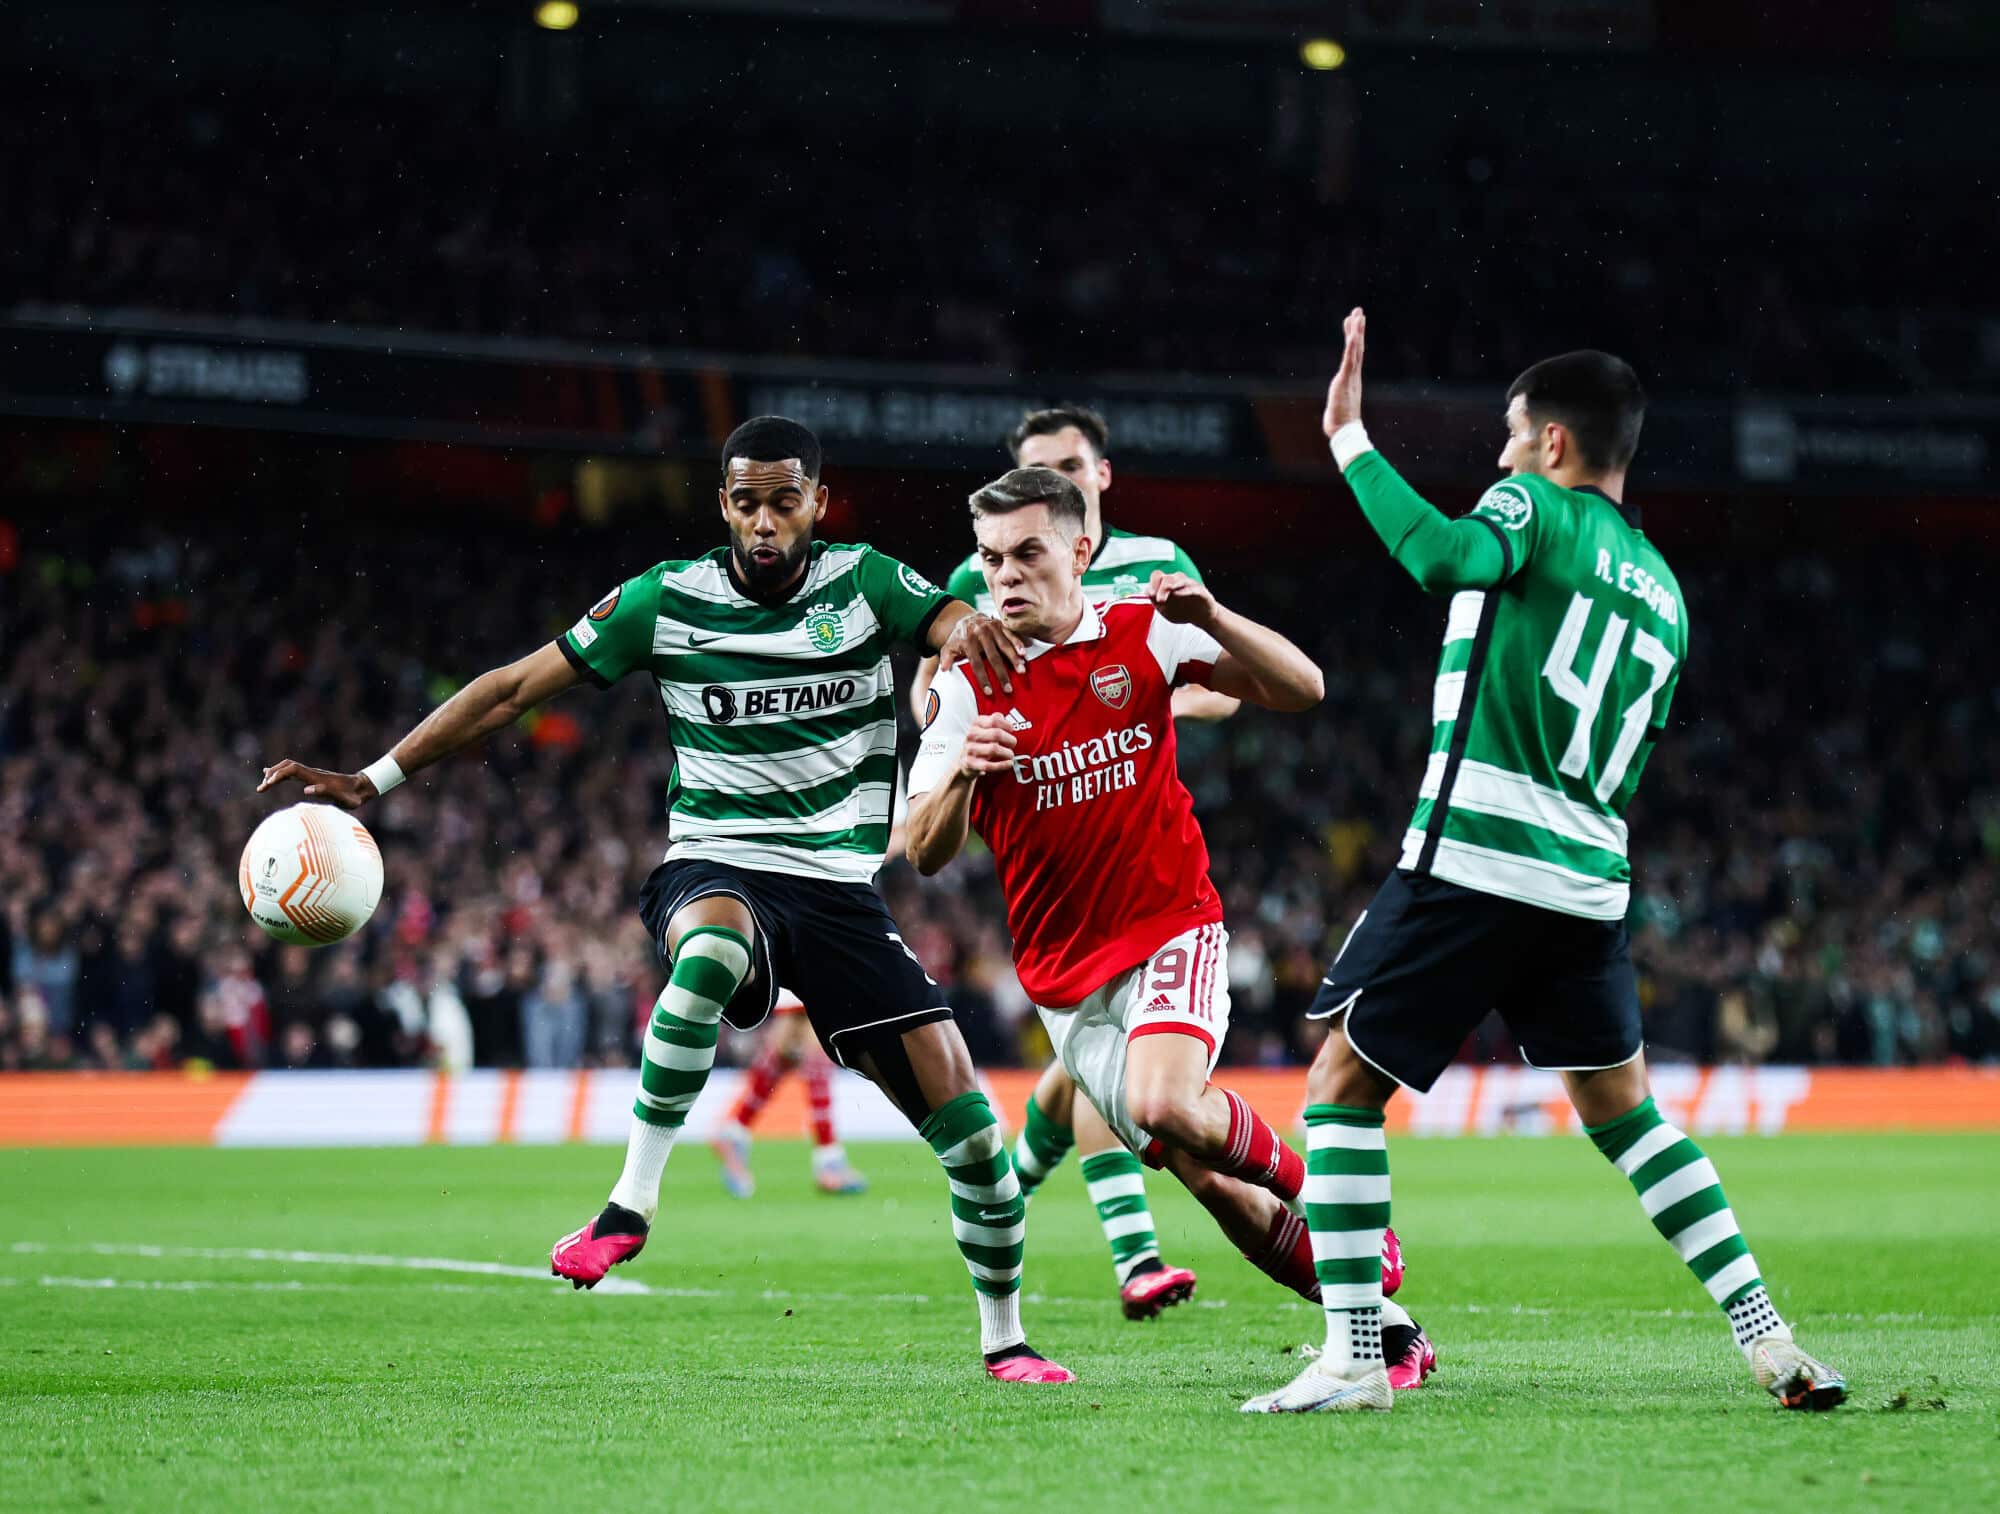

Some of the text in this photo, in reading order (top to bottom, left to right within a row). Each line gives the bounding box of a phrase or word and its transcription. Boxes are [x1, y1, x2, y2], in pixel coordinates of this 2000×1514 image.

[1594, 548, 1614, 585] R.
[806, 603, 834, 616] SCP
[745, 679, 855, 716] BETANO
[1541, 591, 1677, 804] 47
[1012, 723, 1152, 784] Emirates
[1036, 759, 1137, 811] FLY BETTER
[1143, 1004, 1176, 1014] adidas
